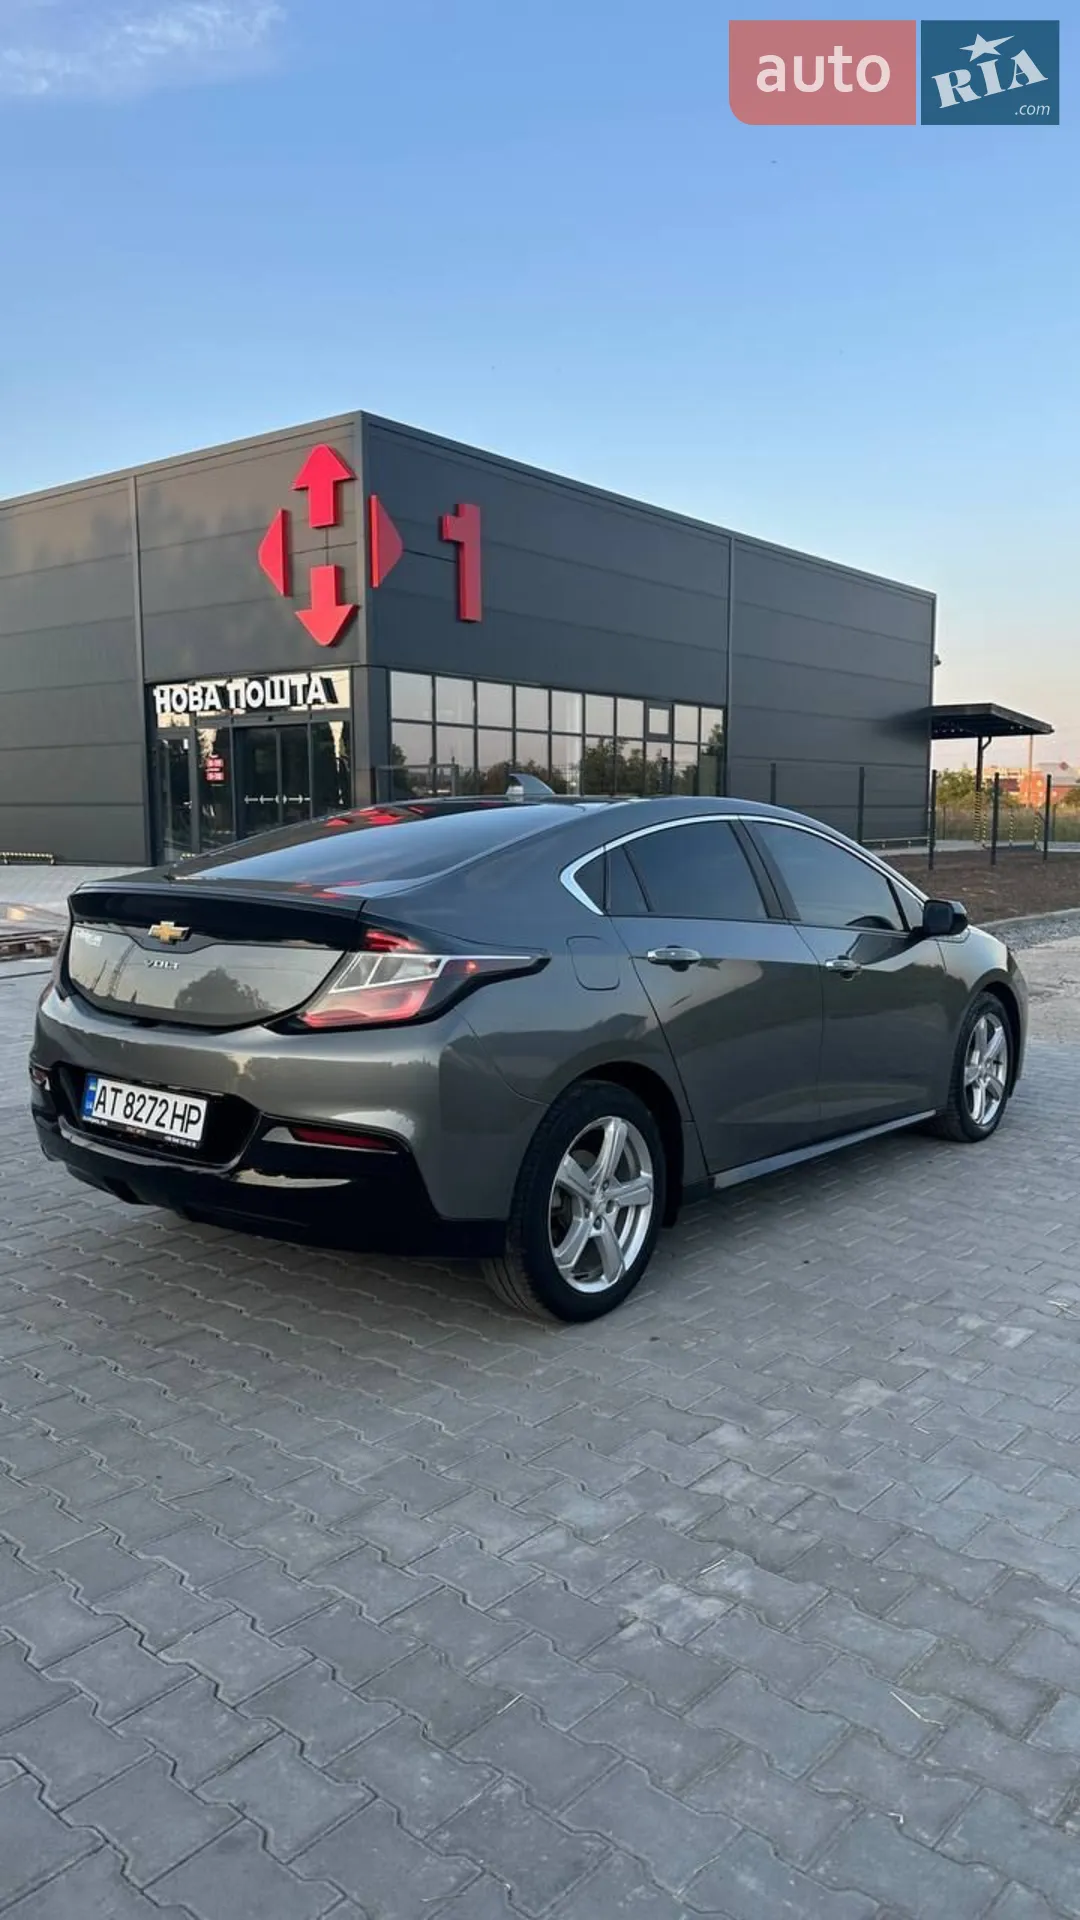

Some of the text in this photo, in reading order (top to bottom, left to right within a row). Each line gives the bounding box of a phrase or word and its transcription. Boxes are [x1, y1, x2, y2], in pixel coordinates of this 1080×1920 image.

[440, 503, 482, 623] 1
[153, 677, 328, 714] НОВА ПОШТА
